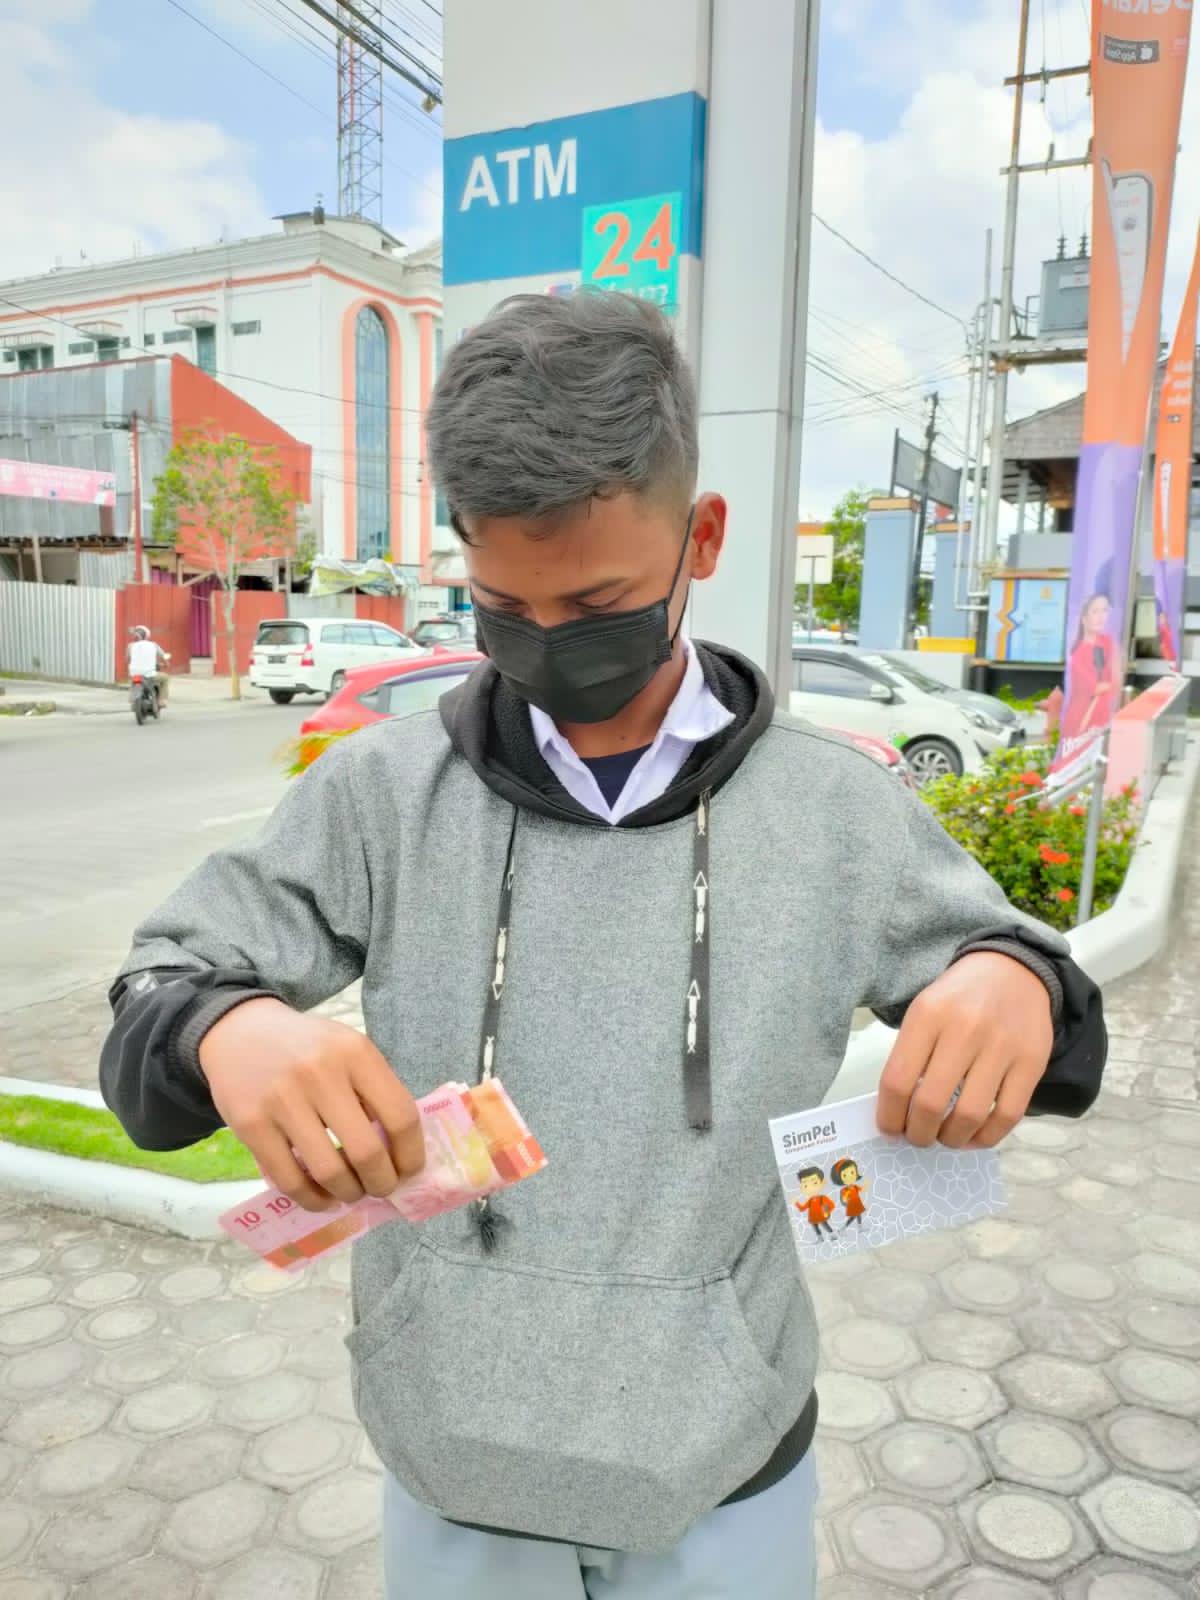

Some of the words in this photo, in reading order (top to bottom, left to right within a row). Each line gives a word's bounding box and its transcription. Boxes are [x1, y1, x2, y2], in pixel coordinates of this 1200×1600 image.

[460, 138, 577, 212] ATM
[592, 202, 676, 279] 24
[782, 1120, 836, 1148] SimPel
[234, 1210, 261, 1228] 10
[265, 1196, 292, 1214] 10
